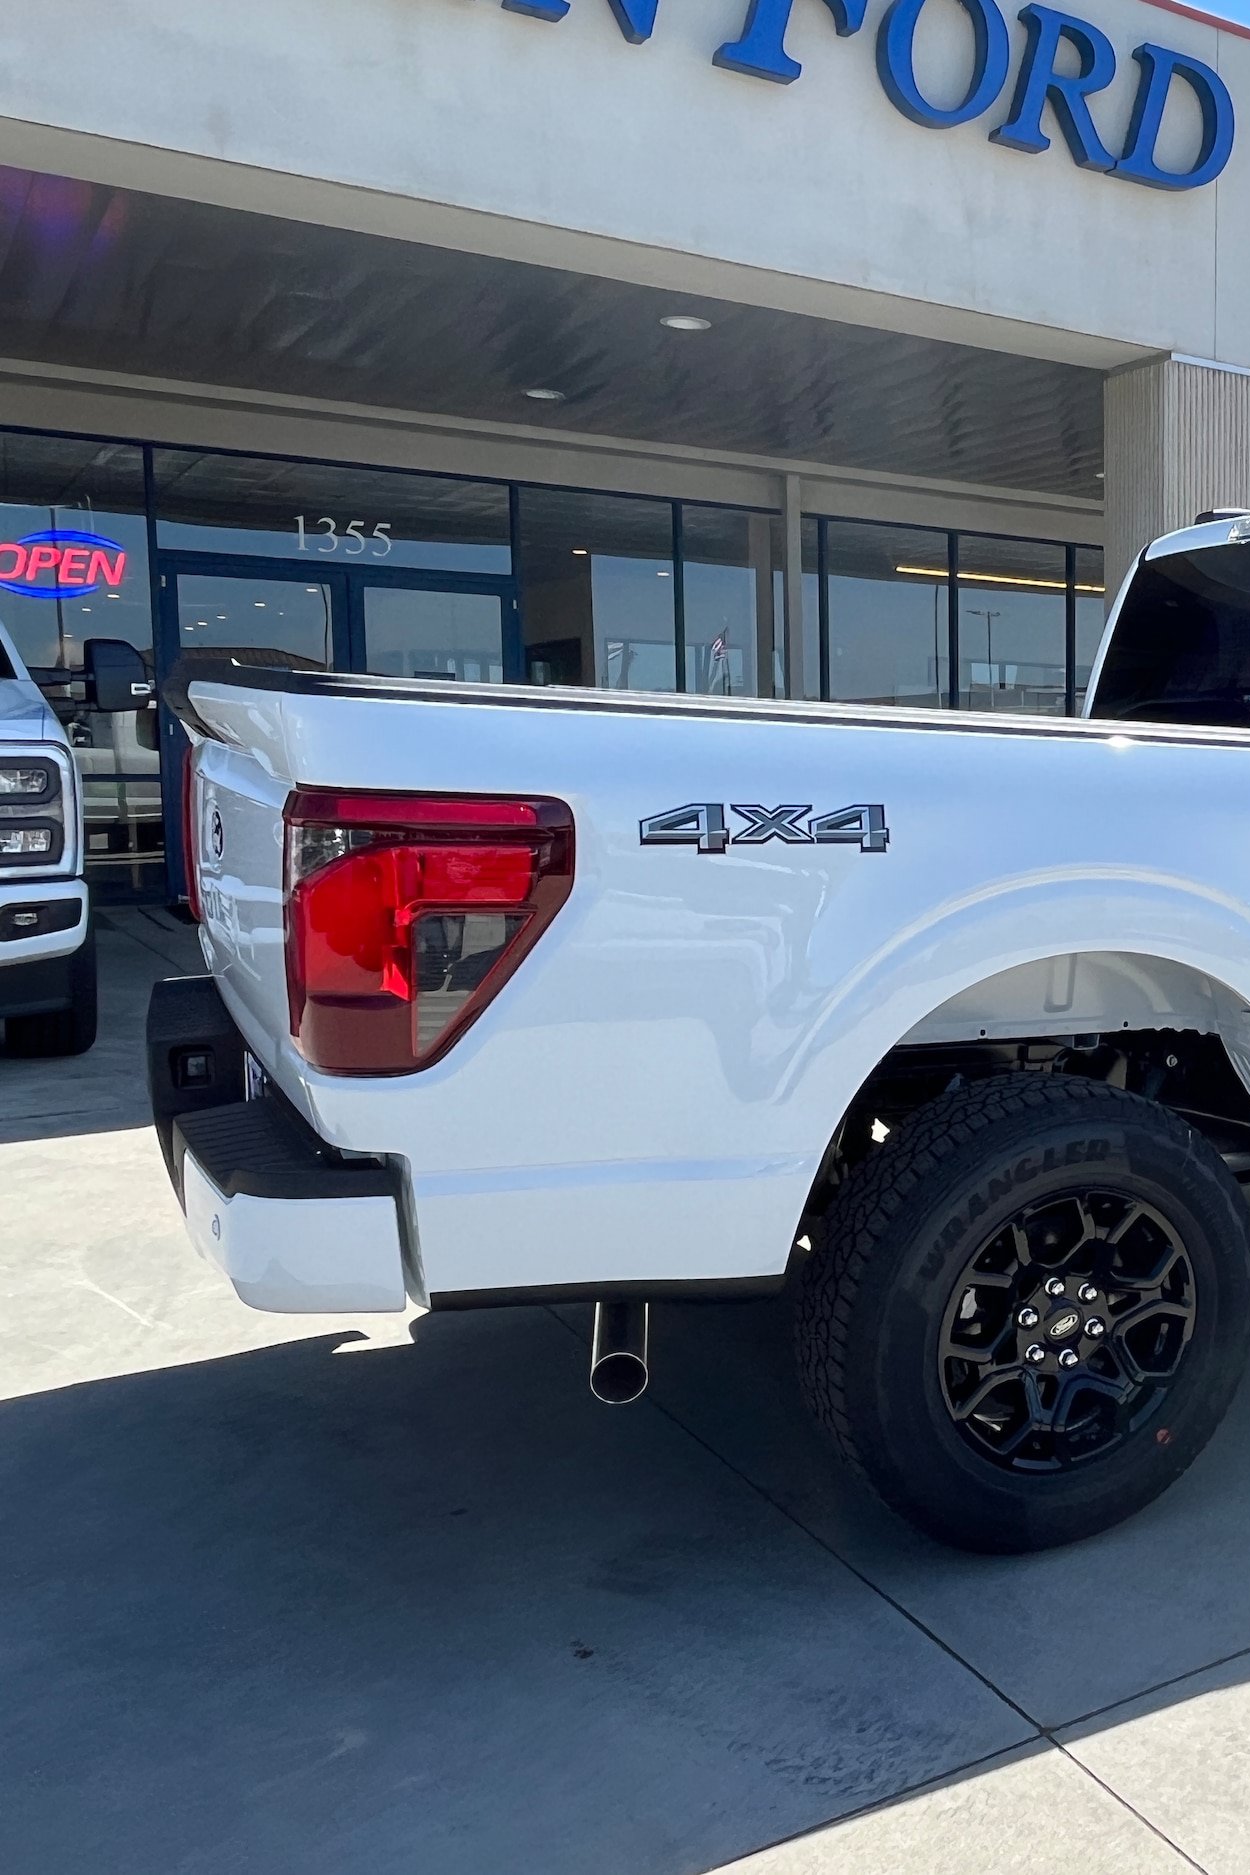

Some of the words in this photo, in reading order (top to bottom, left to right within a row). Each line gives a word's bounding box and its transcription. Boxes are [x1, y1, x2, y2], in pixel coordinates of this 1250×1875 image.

[713, 0, 1235, 191] FORD
[0, 543, 126, 586] OPEN
[293, 515, 392, 556] 1355
[915, 1138, 1112, 1282] WRANGLER
